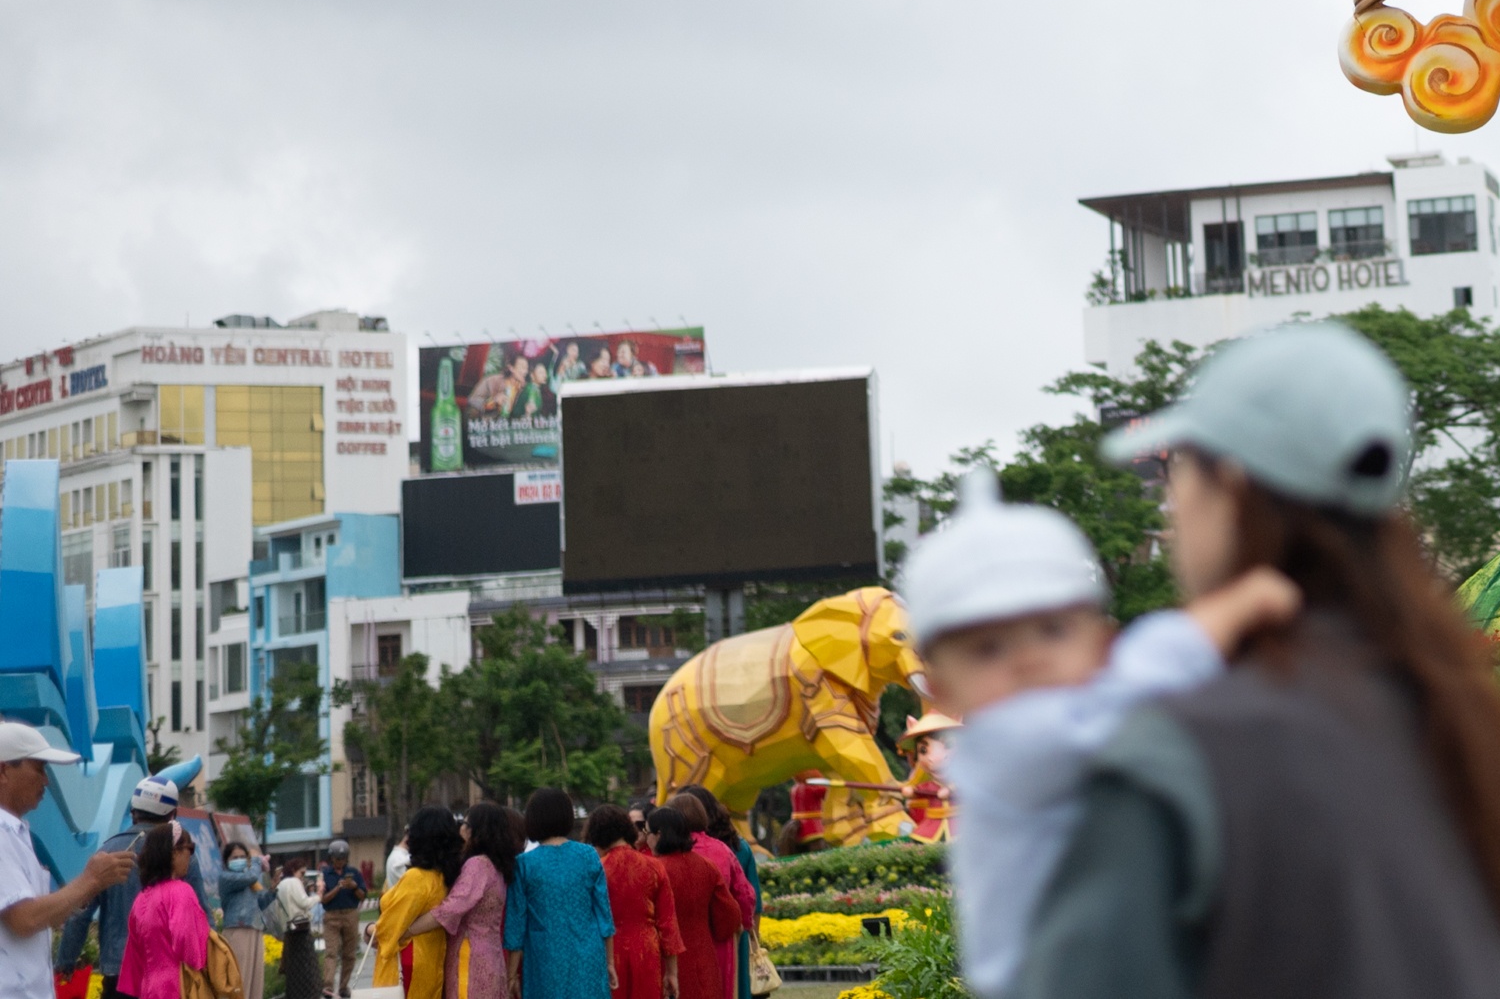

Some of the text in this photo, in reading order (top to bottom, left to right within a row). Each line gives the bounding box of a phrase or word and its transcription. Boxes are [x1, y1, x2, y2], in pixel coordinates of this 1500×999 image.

[1248, 259, 1409, 297] MENTO HOTEL
[142, 342, 204, 365] HOÀNG
[254, 348, 332, 368] CENTRAL
[339, 351, 393, 370] HOTEL
[70, 364, 108, 396] HOTEL
